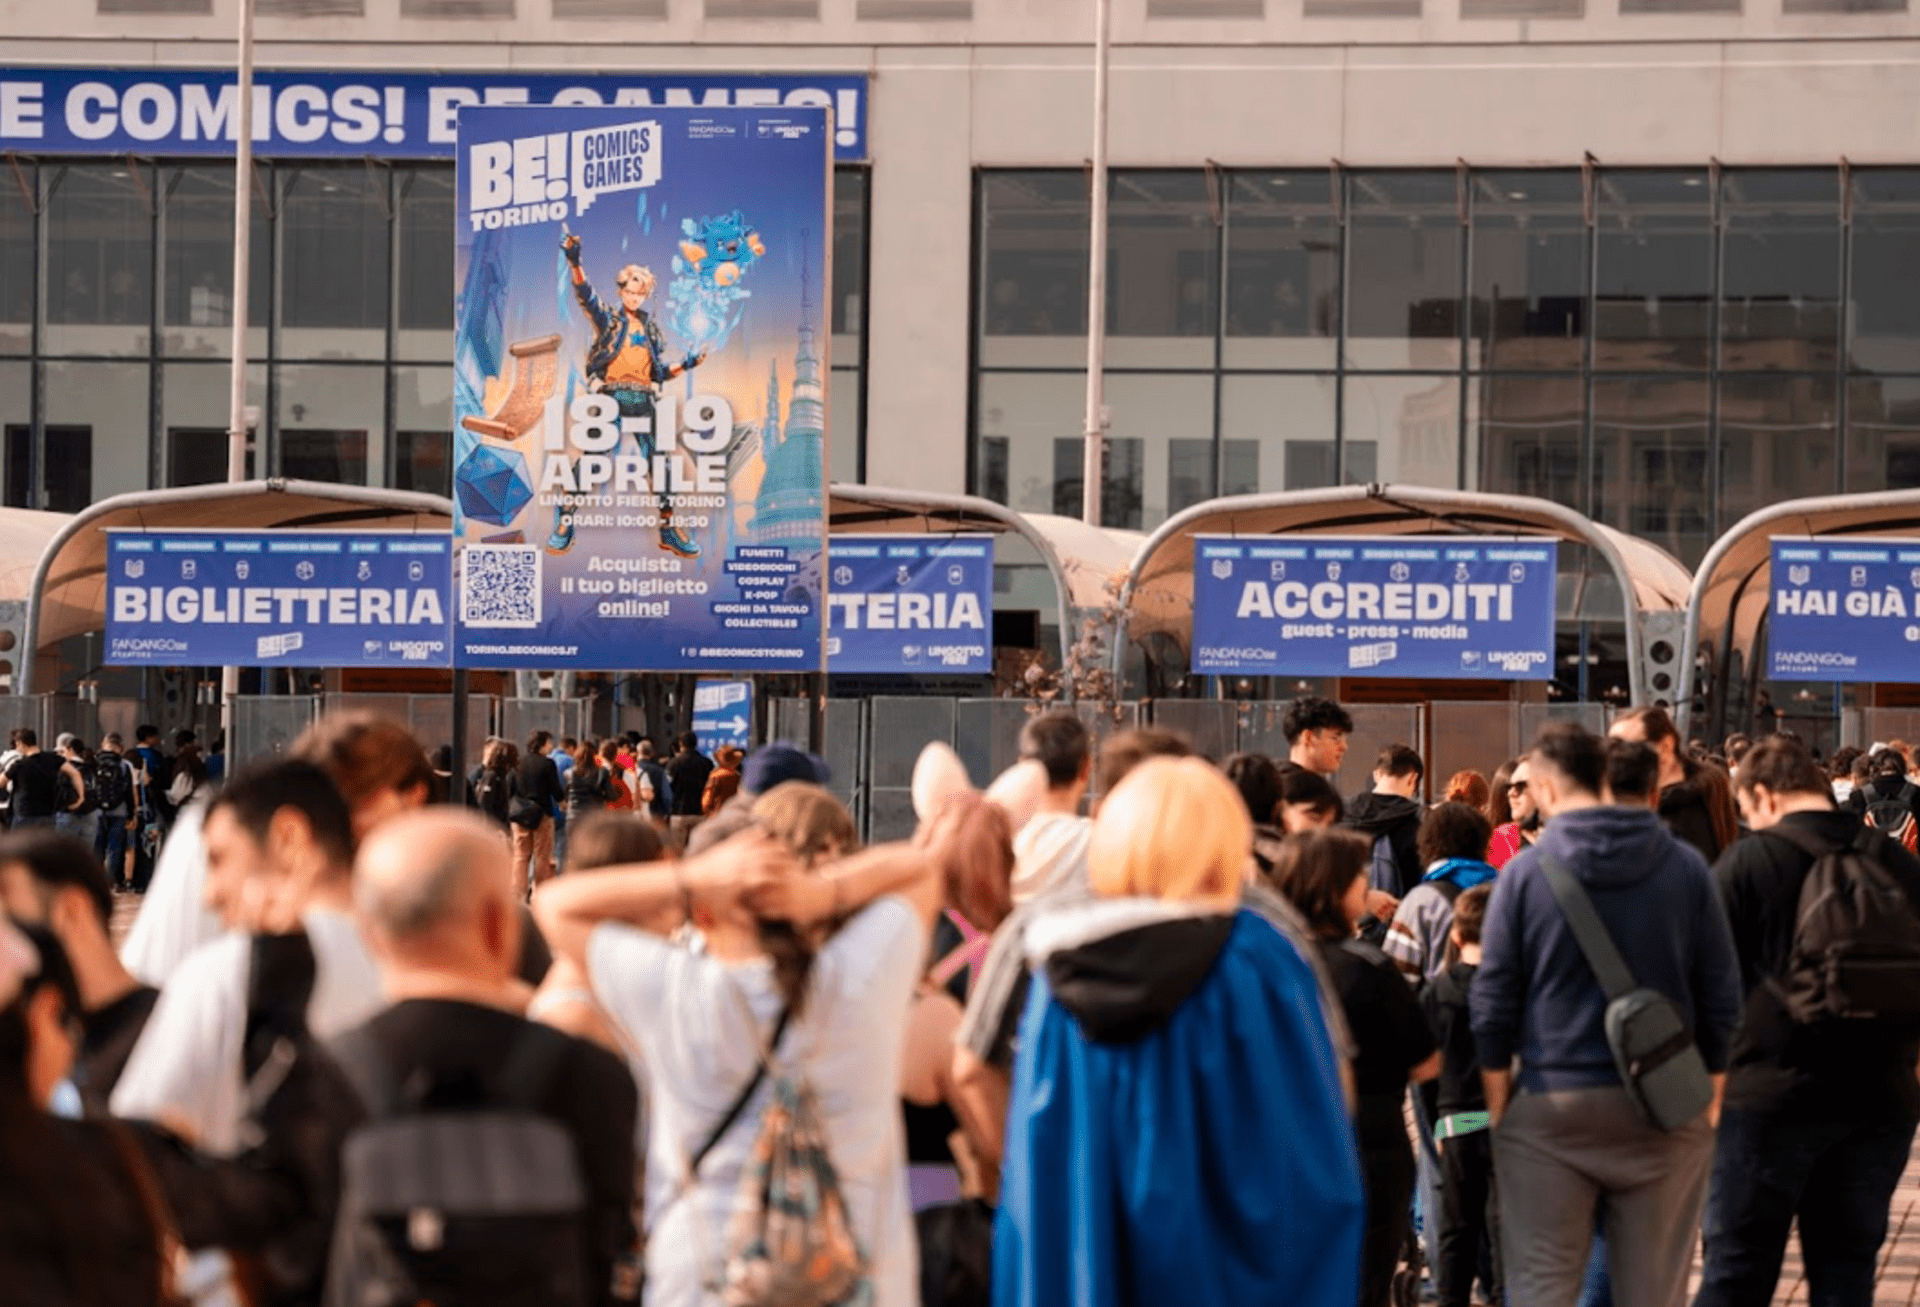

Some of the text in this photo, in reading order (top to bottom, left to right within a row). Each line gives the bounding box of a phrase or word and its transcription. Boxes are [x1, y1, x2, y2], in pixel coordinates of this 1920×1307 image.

[64, 83, 406, 144] COMICS!
[583, 127, 650, 162] COMICS
[470, 131, 569, 211] BE!
[583, 155, 643, 189] GAMES
[470, 201, 569, 232] TORINO
[543, 393, 734, 453] 18-19
[539, 454, 727, 493] APRILE
[539, 494, 614, 507] LINGOTTO
[667, 495, 727, 508] TORINO
[561, 514, 614, 527] ORARI:
[616, 514, 657, 527] 10:00
[739, 548, 785, 558] FUMETTI
[587, 556, 682, 574] Acquista
[578, 578, 614, 594] tuo
[618, 578, 708, 597] biglietto
[738, 576, 785, 586] COSPLAY
[744, 590, 778, 600] K-POP
[1236, 581, 1513, 621] ACCREDITI
[1776, 589, 1838, 616] HAI
[1844, 584, 1908, 618] GIÀ
[113, 586, 444, 625] BIGLIETTERIA
[598, 600, 671, 617] online!
[714, 604, 809, 614] GIOCHI DA TAVOLO
[725, 618, 798, 628] COLLECTIBLES
[1281, 623, 1335, 639] guest
[1348, 625, 1399, 640] press
[1412, 624, 1469, 639] media
